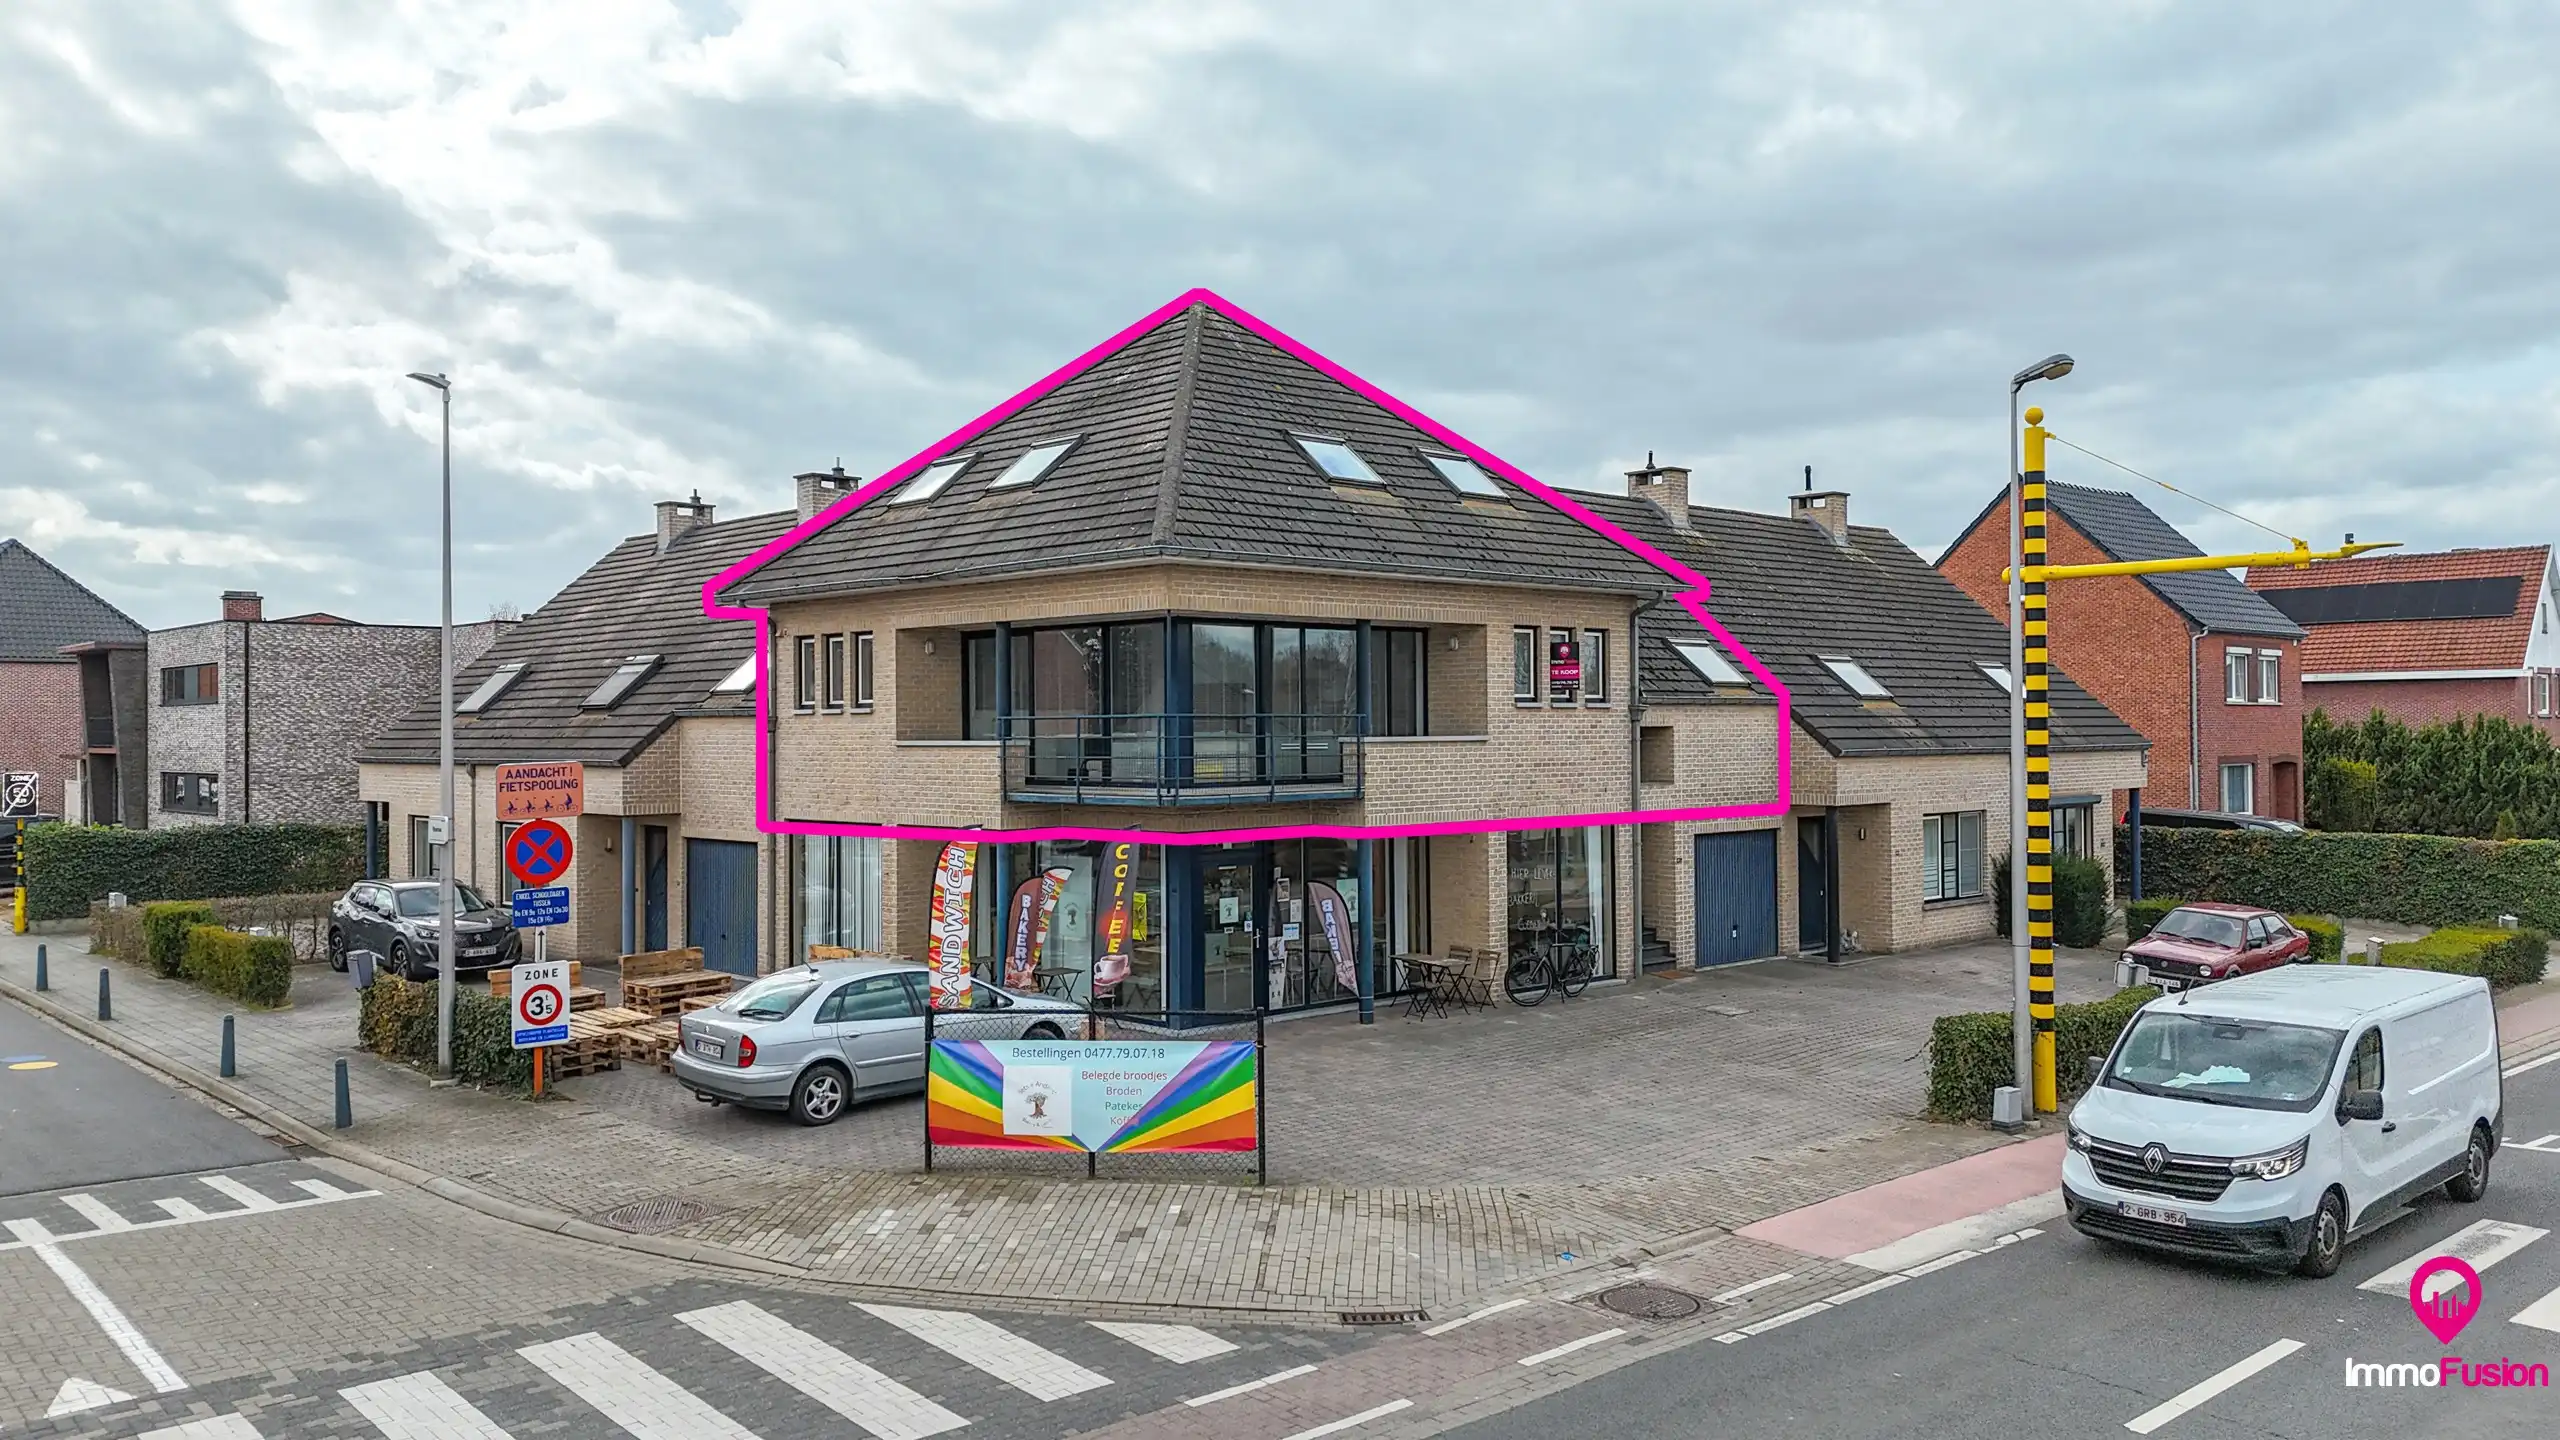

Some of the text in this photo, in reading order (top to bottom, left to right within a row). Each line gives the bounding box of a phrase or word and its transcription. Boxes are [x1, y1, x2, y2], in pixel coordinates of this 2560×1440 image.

[499, 779, 579, 793] FIETSPOOLING
[938, 848, 966, 1009] SANDWICH
[1014, 893, 1032, 973] BAKERY
[525, 968, 559, 981] ZONE
[1012, 1047, 1165, 1061] Bestellingen 0477.79.07.18
[1081, 1071, 1168, 1082] Belegde broodjes
[1106, 1086, 1143, 1096] Broden
[1105, 1101, 1143, 1111] Patekes
